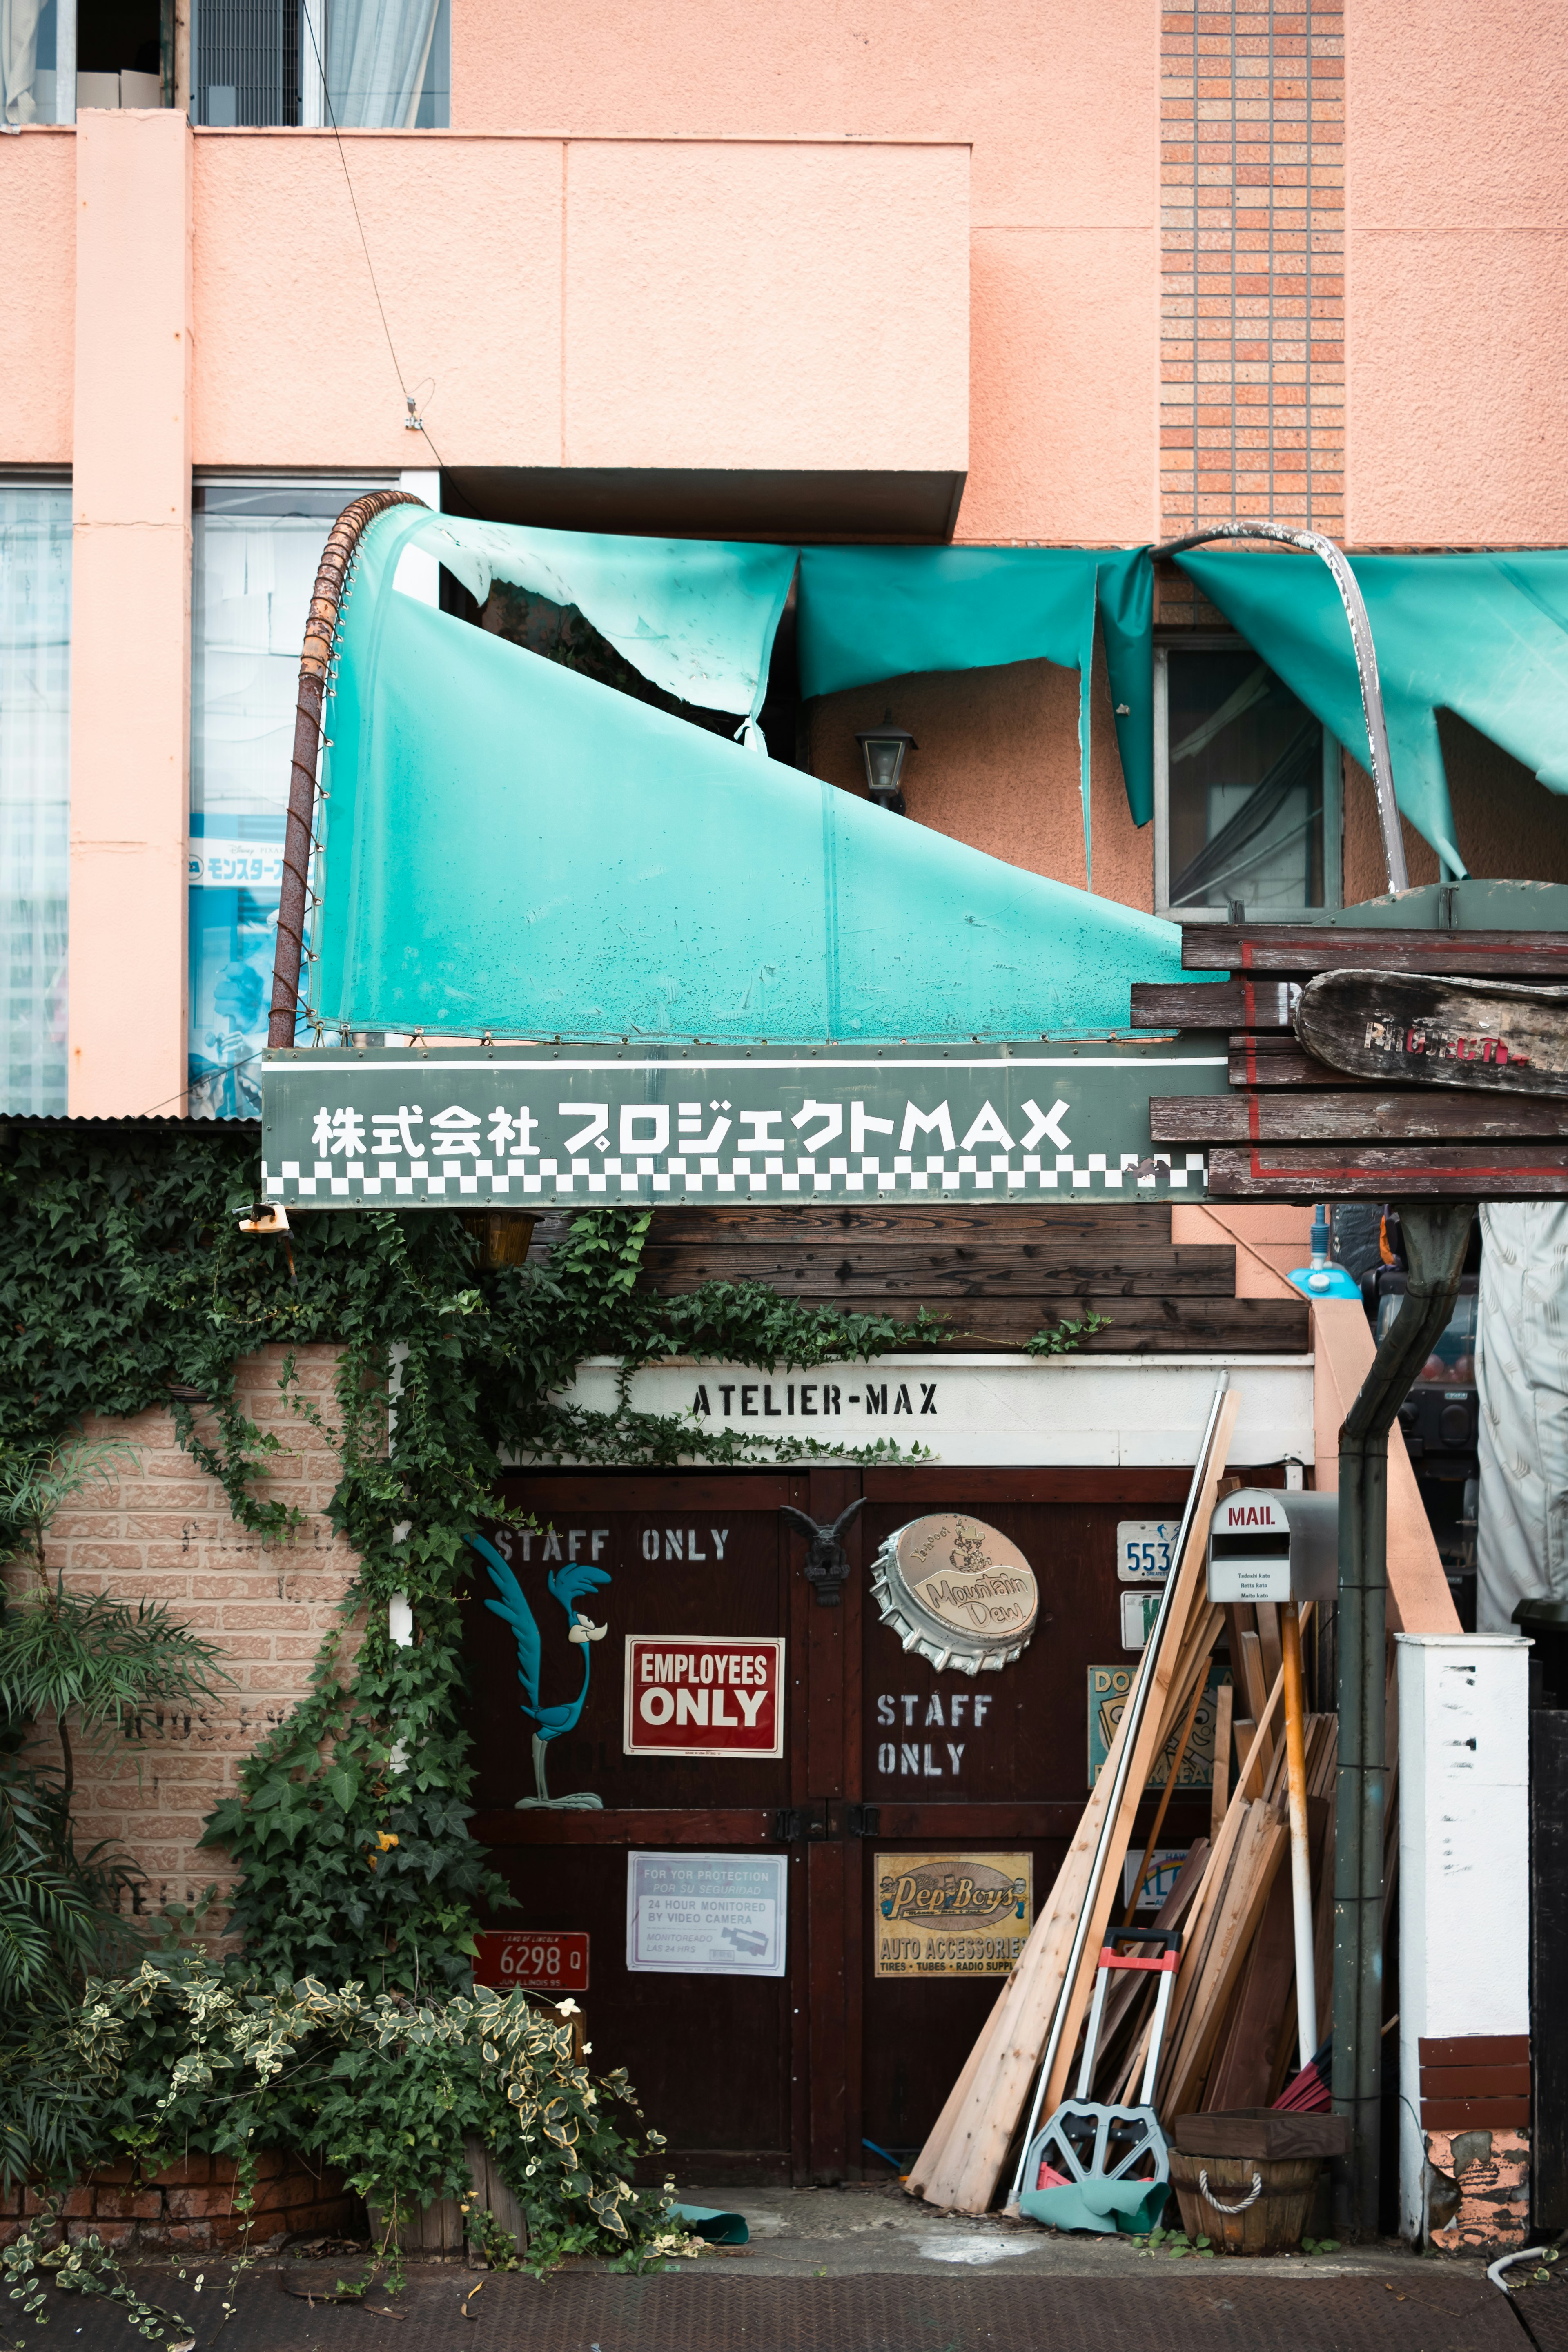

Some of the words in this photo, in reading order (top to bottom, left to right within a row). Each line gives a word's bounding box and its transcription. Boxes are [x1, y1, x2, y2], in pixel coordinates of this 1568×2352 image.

[229, 844, 254, 855] Disney
[312, 1105, 540, 1158] 株式会社
[695, 1383, 937, 1416] ATELIER-MAX
[1229, 1506, 1275, 1526] MAIL
[495, 1530, 609, 1561] STAFF
[643, 1529, 729, 1560] ONLY
[1127, 1543, 1169, 1571] 553
[926, 1573, 1028, 1609] Mountain
[958, 1601, 1023, 1628] Dew
[641, 1653, 767, 1685] EMPLOYEES
[640, 1687, 768, 1727] ONLY
[877, 1695, 992, 1726] STAFF
[878, 1743, 965, 1776] ONLY
[644, 1870, 666, 1879] FOR
[671, 1871, 693, 1880] YOR
[698, 1871, 768, 1882] PROTECTION
[653, 1884, 675, 1893] POR
[680, 1884, 695, 1893] SU
[699, 1884, 761, 1895] SEGURIDAD
[916, 1873, 938, 1886] The
[648, 1900, 660, 1909] 24
[665, 1900, 696, 1910] HOUR
[701, 1901, 766, 1912] MONITORED
[888, 1876, 946, 1918] Pep
[953, 1878, 1015, 1909] Boys
[648, 1913, 663, 1922] BY
[668, 1913, 701, 1923] VIDEO
[705, 1914, 752, 1925] CAMERA
[646, 1933, 713, 1942] MONITOREADO
[880, 1937, 920, 1959] AUTO
[500, 1946, 560, 1975] 6298
[570, 1951, 581, 1969] Q
[880, 1962, 906, 1971] TIRES
[917, 1962, 945, 1971] TUBES
[956, 1962, 983, 1971] RADIO
